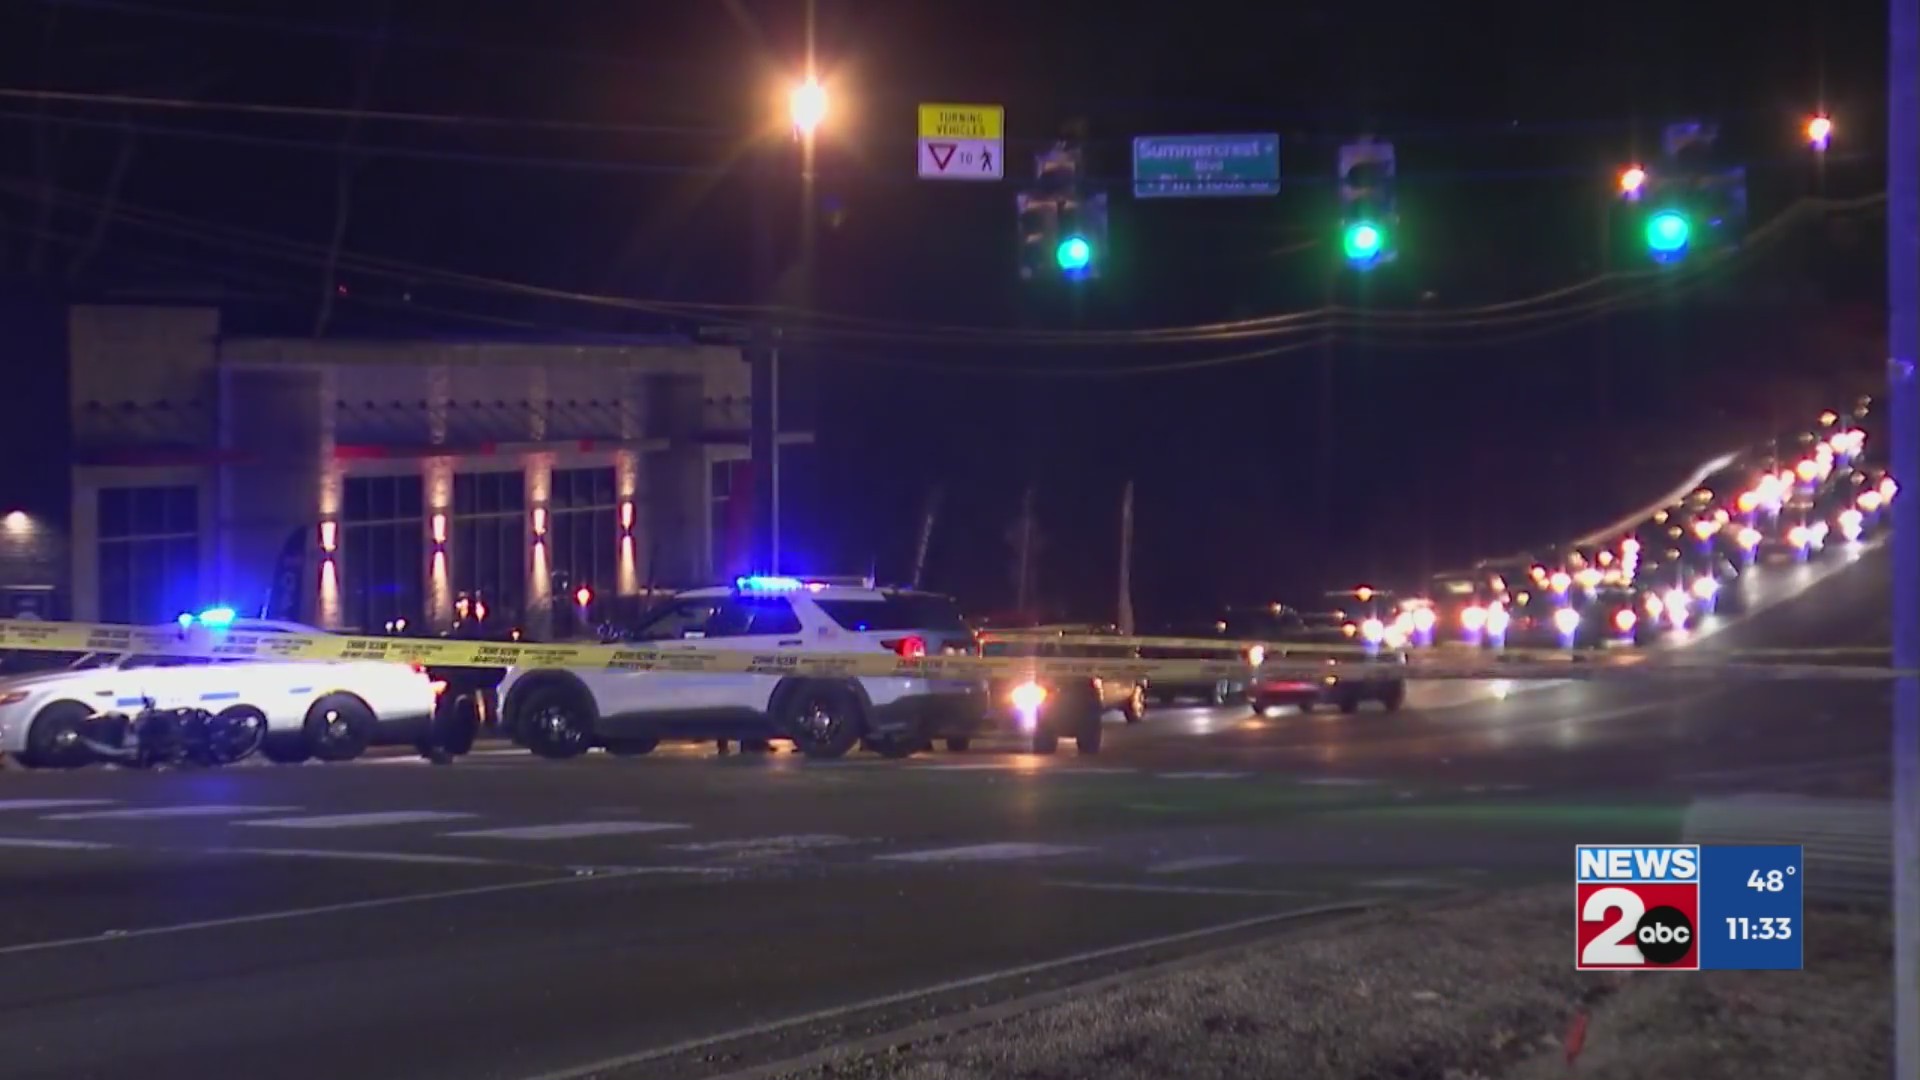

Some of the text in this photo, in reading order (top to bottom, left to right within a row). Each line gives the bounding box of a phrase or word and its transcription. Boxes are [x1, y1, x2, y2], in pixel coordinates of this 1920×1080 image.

[939, 111, 984, 123] TURNING
[936, 124, 987, 137] VEHICLES
[1138, 139, 1261, 159] Summercrest
[960, 151, 973, 165] TO
